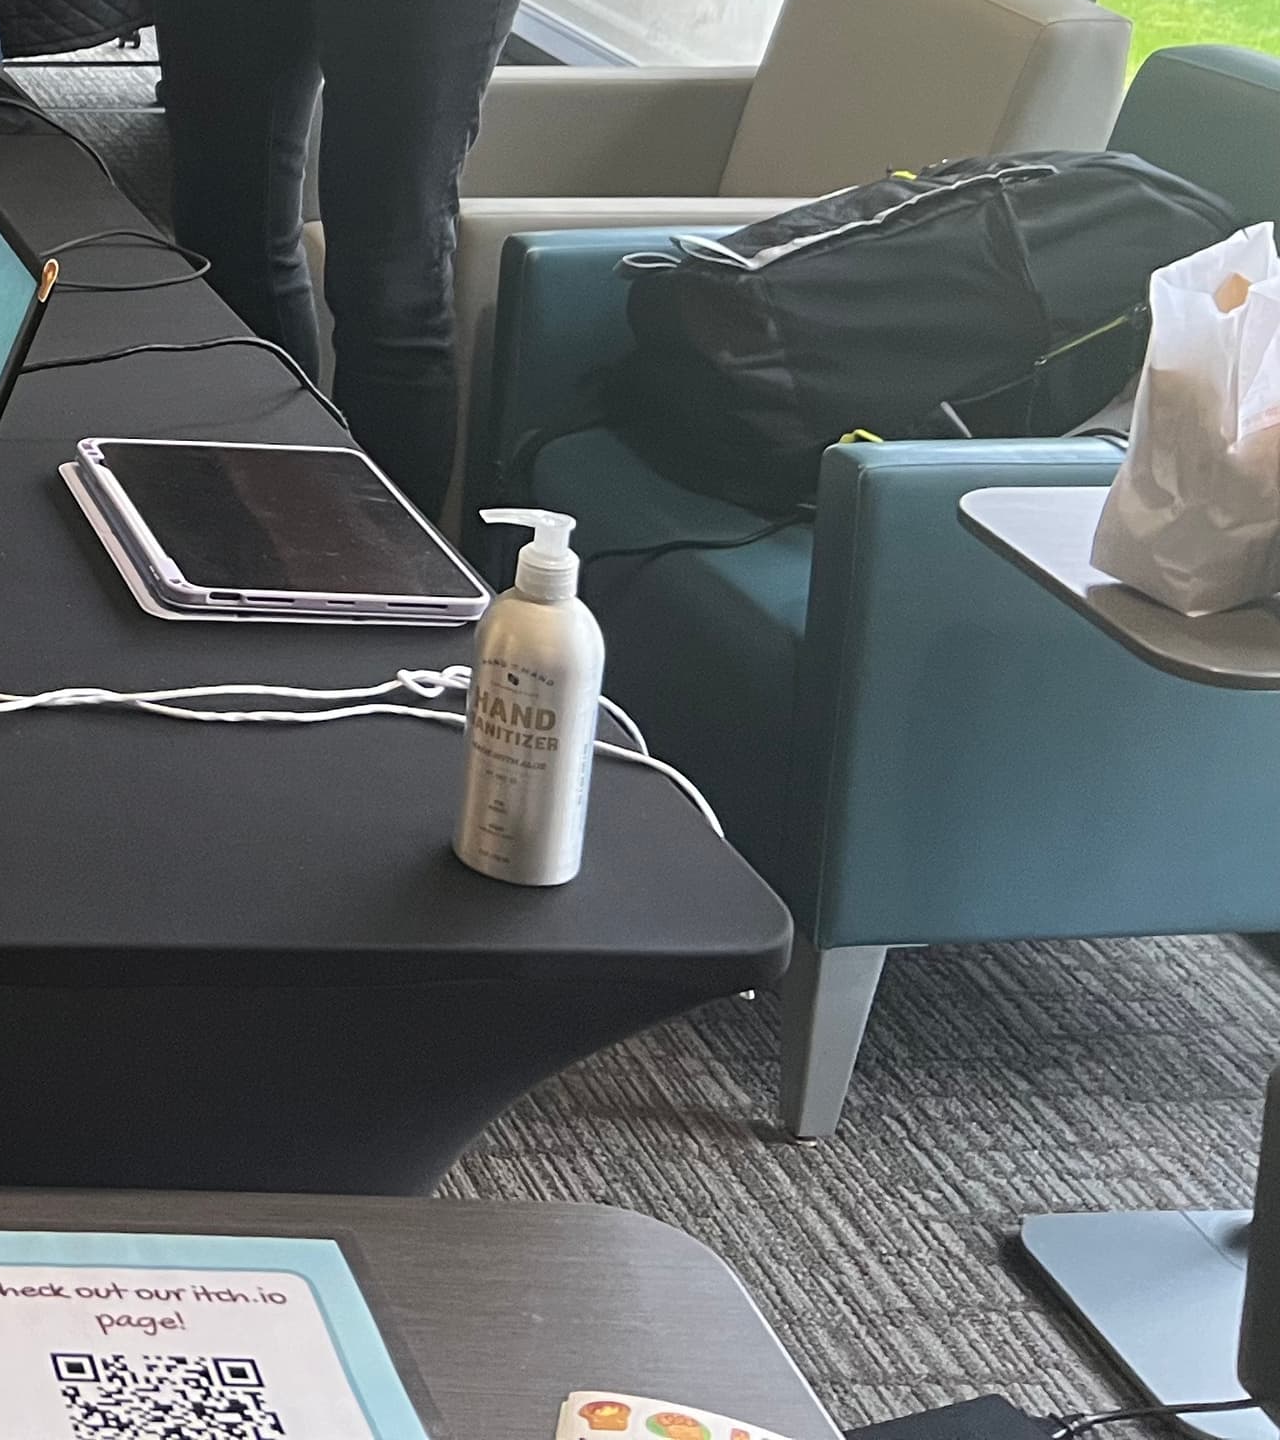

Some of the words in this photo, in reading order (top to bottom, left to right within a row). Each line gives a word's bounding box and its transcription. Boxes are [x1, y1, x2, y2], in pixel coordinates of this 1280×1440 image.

[473, 686, 557, 731] HAND
[75, 1282, 128, 1301] out
[134, 1286, 187, 1302] our
[191, 1285, 287, 1305] itch.io
[95, 1312, 186, 1336] page!
